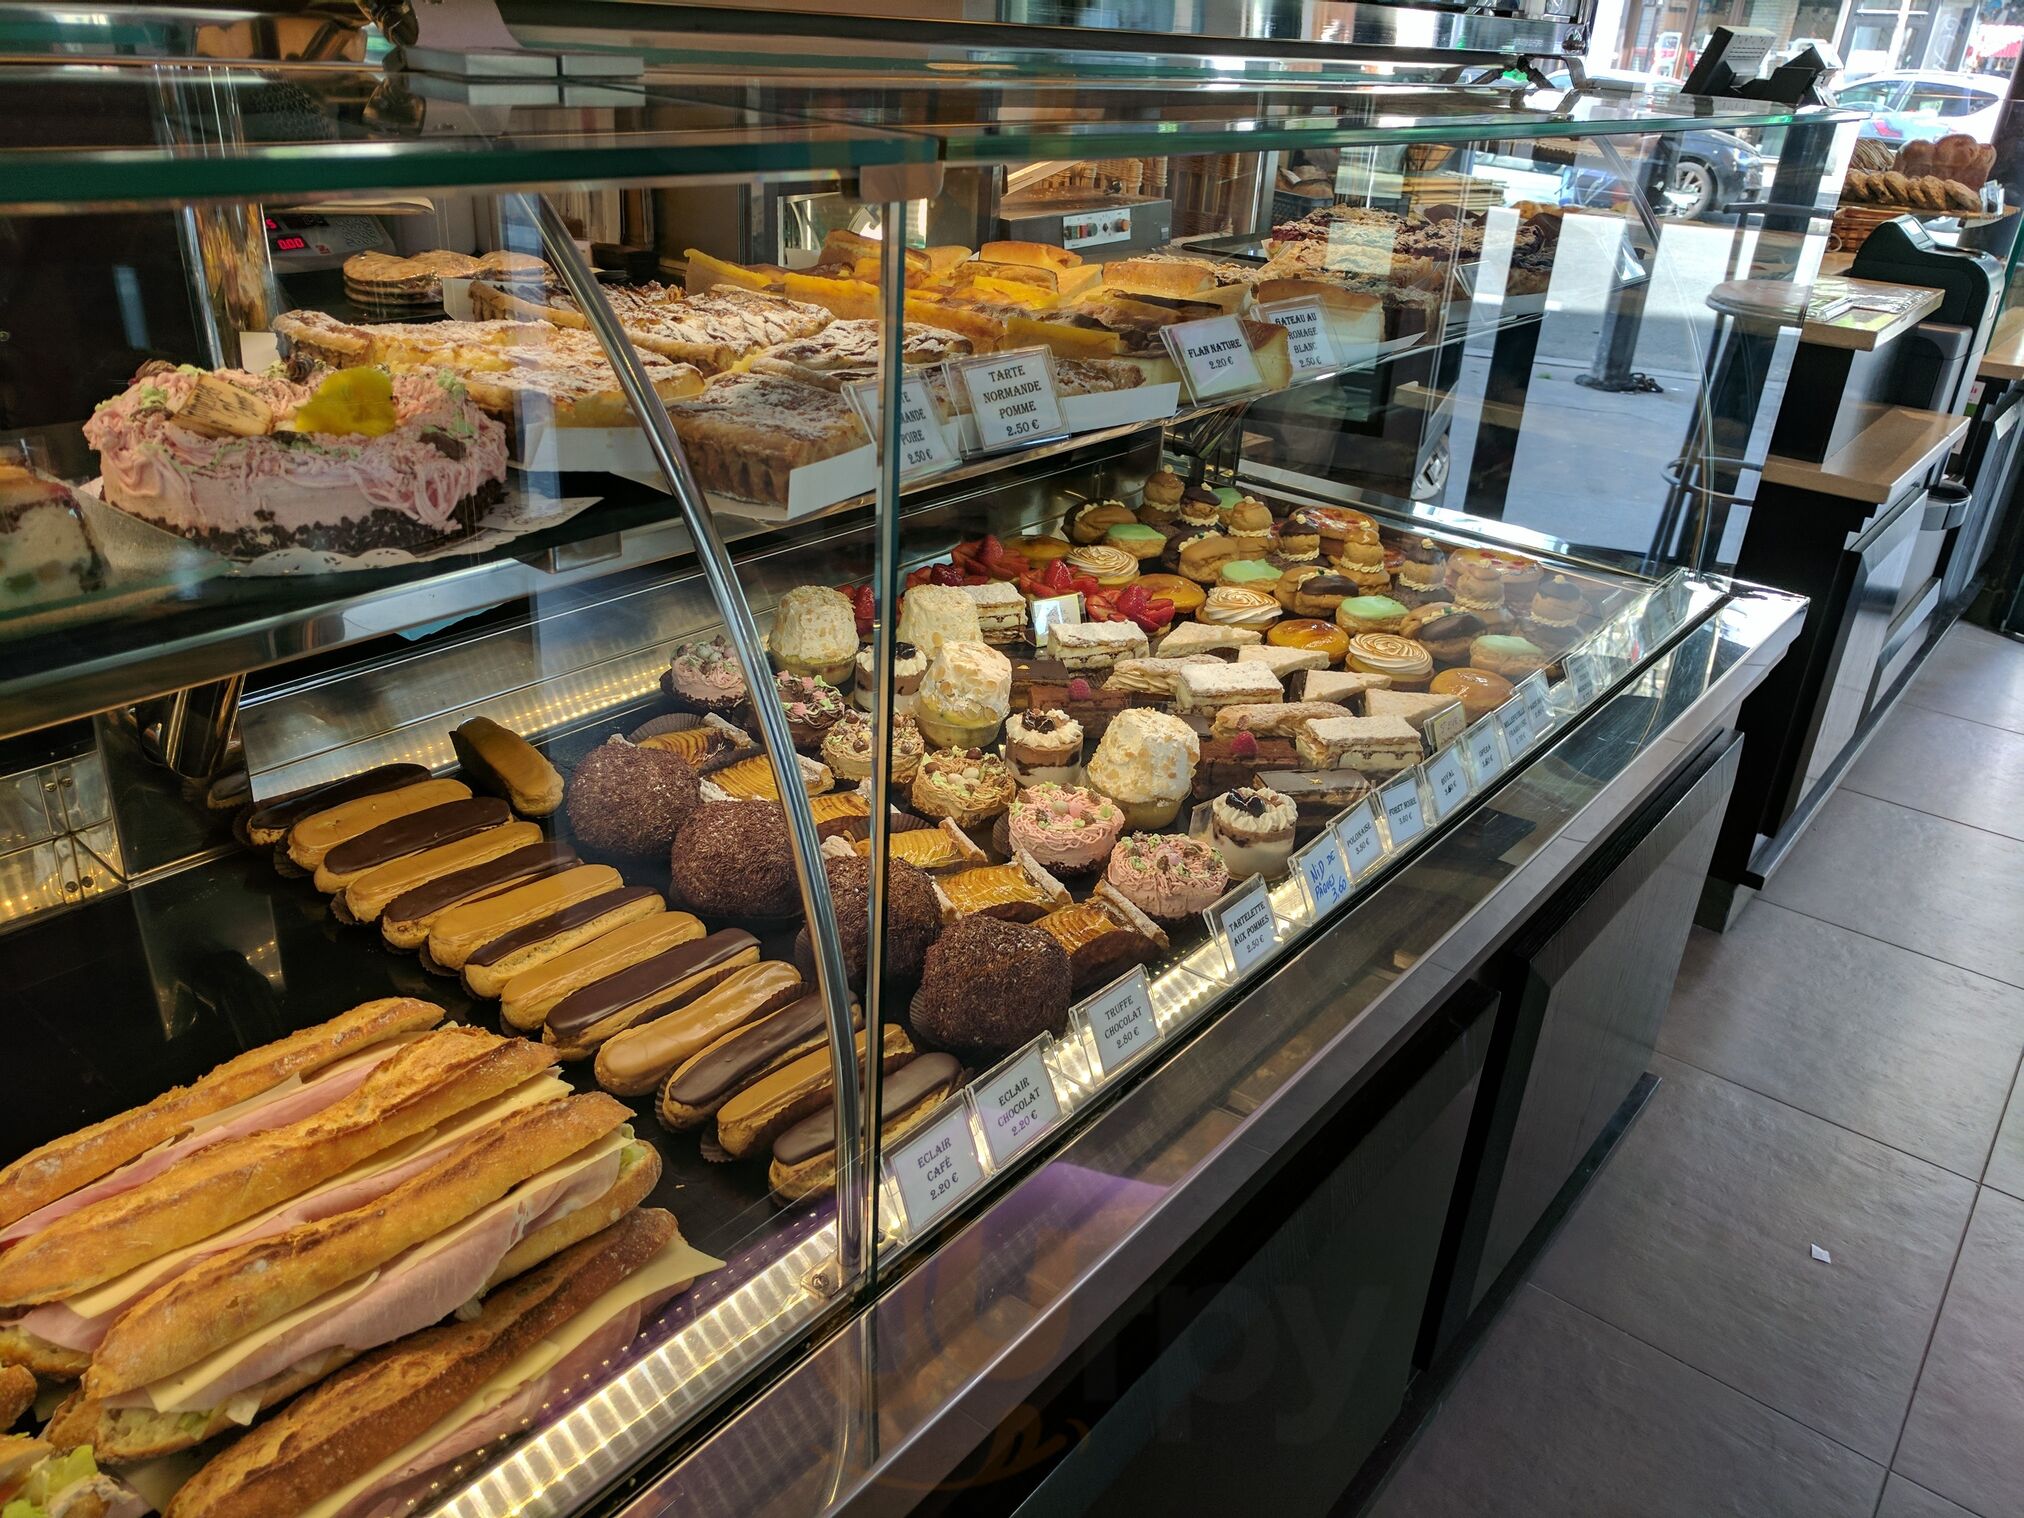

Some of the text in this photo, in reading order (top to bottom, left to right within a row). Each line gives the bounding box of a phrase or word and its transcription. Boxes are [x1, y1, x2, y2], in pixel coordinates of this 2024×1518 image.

[1306, 312, 1317, 322] AU
[1288, 327, 1318, 340] ROMAGE
[1188, 338, 1242, 358] FLAN NATURE
[988, 365, 1025, 382] TARTE
[1209, 358, 1227, 369] 2.20
[983, 380, 1042, 404] NORMANDE
[999, 400, 1036, 419] POMME
[1006, 421, 1030, 436] 2.50
[907, 450, 926, 464] 2.50
[1346, 822, 1372, 848] POLONAISE
[1228, 901, 1266, 932] TARTELETTE
[1234, 914, 1270, 947] AUX POMMES
[1246, 938, 1260, 953] 2.50
[1105, 995, 1133, 1020] TRUFFE
[1104, 1006, 1142, 1039] CHOCOLAT
[998, 1077, 1030, 1106] ECLAIR
[997, 1087, 1040, 1127] CHOCOLAT
[1011, 1115, 1030, 1136] 2.20
[917, 1137, 952, 1168] ECLAIR
[930, 1179, 951, 1200] 2.20
